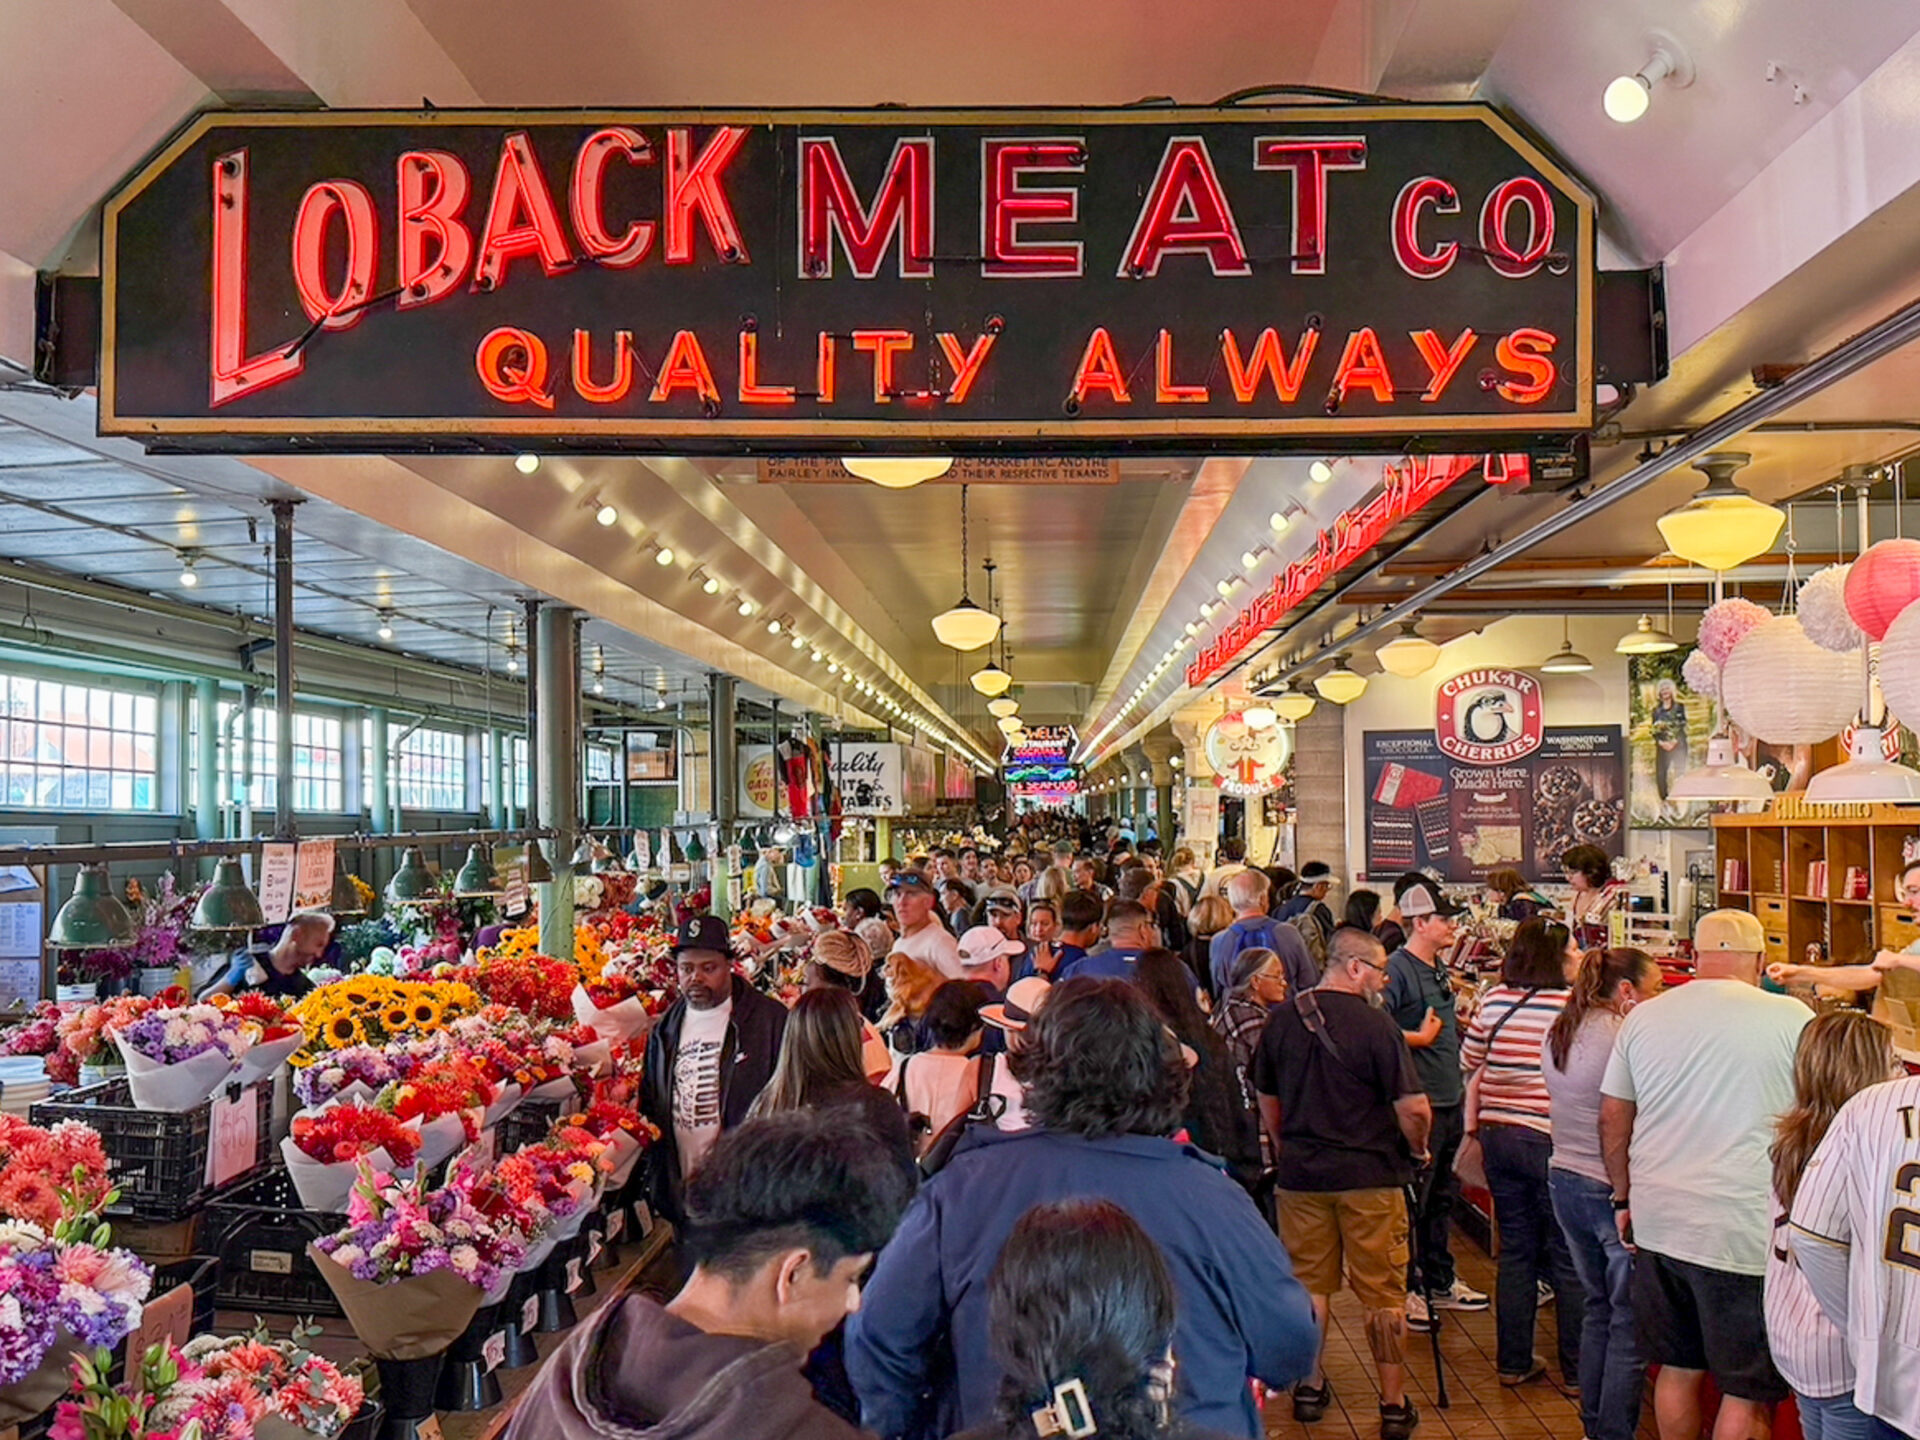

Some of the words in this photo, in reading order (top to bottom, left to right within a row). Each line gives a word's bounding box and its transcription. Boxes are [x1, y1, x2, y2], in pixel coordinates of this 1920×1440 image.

[209, 125, 752, 407] LOBACK
[798, 135, 1366, 279] MEAT
[1390, 174, 1556, 279] CO
[475, 325, 1000, 408] QUALITY
[1073, 327, 1558, 404] ALWAYS
[768, 468, 821, 478] FAIRLEY
[962, 468, 996, 479] THEIR
[1001, 468, 1058, 479] RESPECTIVE
[1063, 468, 1109, 478] TENANTS
[1442, 670, 1533, 697] CHUKAR
[1442, 733, 1536, 760] CHERRIES
[1546, 735, 1608, 744] WASHINGTON
[830, 751, 886, 775] uality
[1450, 766, 1494, 779] Grown
[1496, 766, 1530, 778] Here.
[1221, 778, 1274, 794] PRODUCE
[1455, 778, 1490, 789] Made
[1493, 778, 1526, 789] Here.
[688, 919, 701, 938] S
[694, 1041, 721, 1128] ATTITUDE
